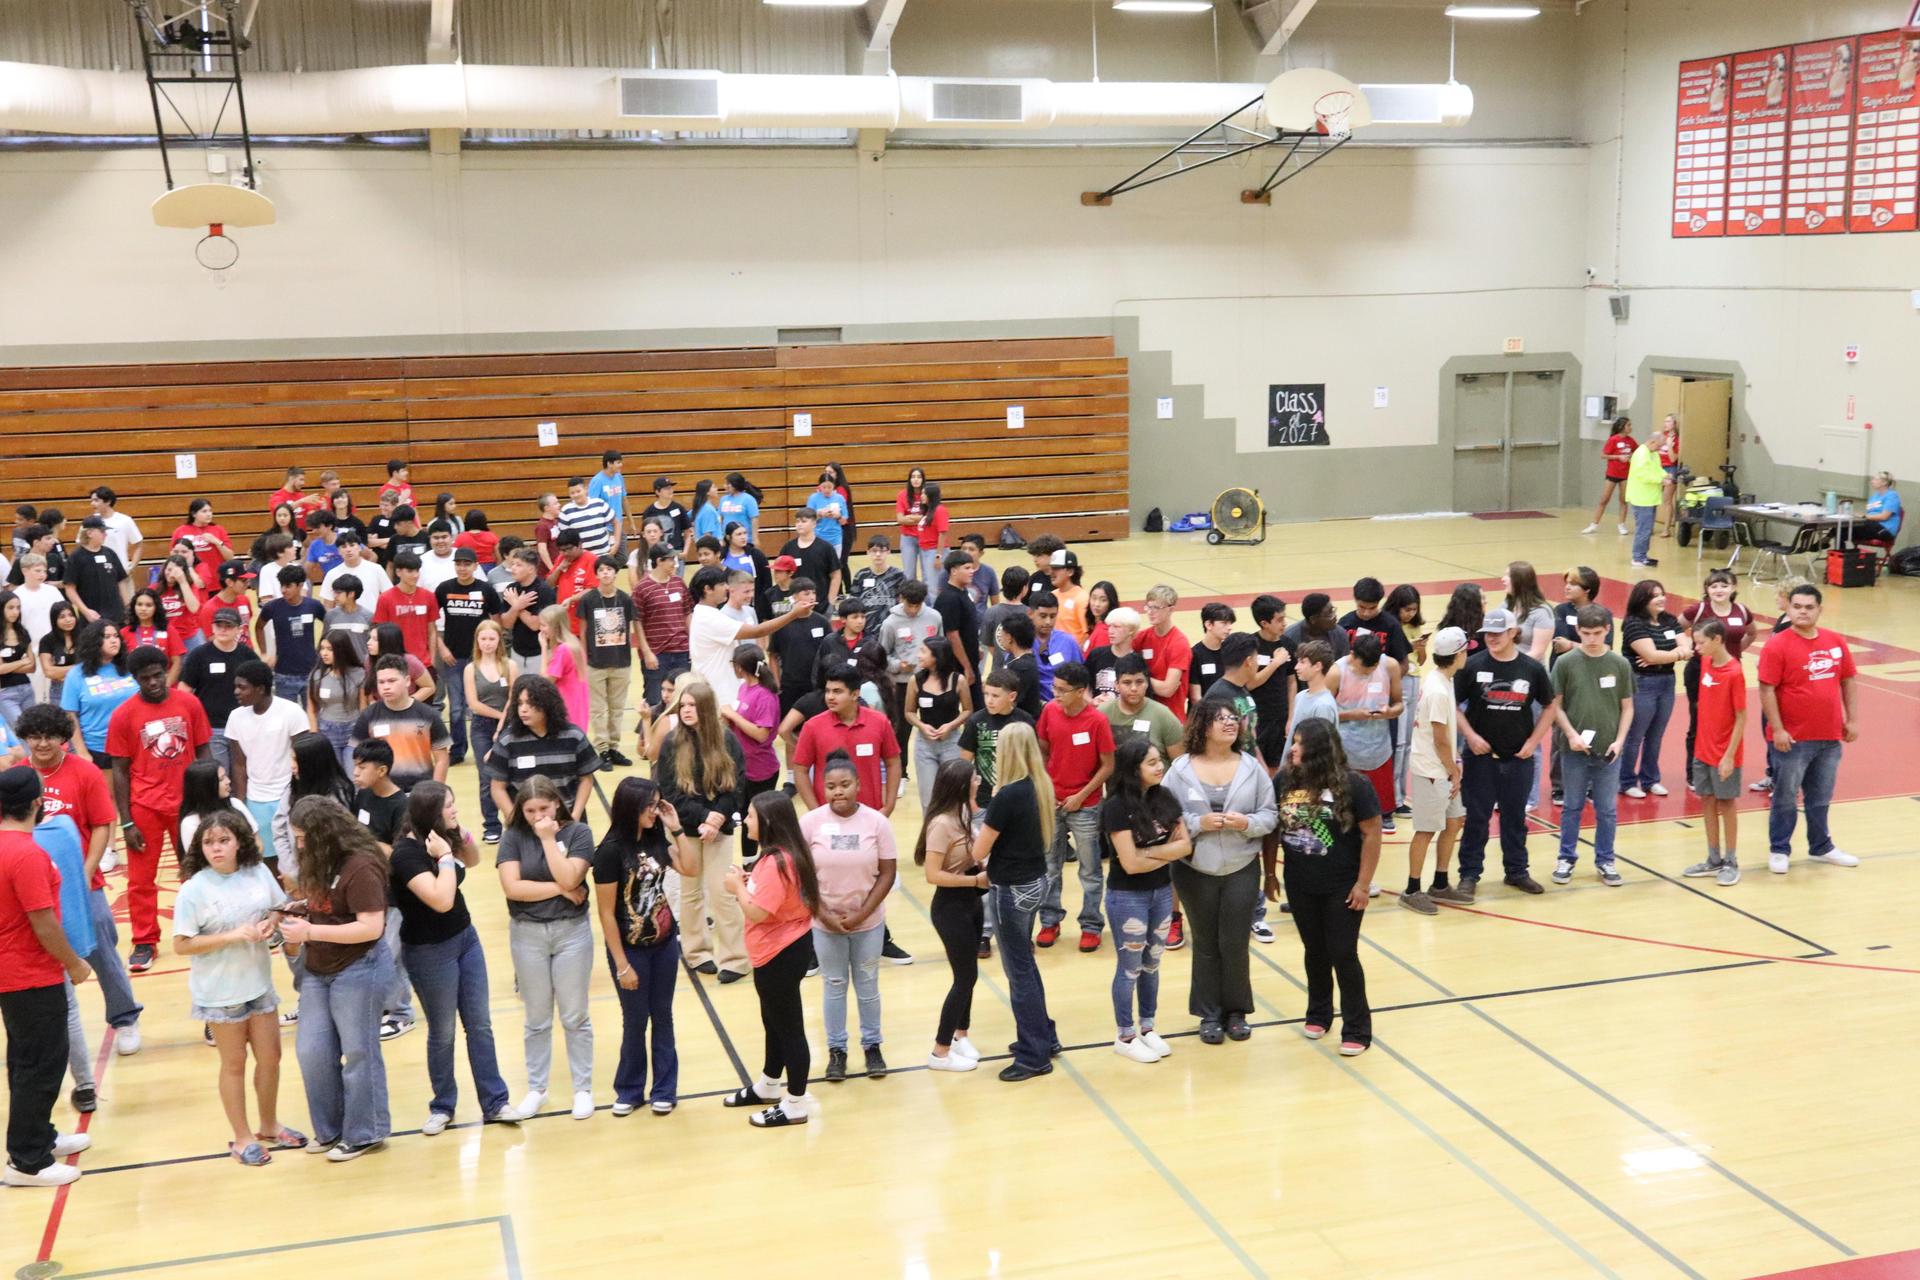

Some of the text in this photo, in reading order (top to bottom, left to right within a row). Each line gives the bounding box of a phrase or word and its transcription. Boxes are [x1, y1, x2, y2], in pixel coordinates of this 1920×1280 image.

[1275, 391, 1317, 414] Class
[1279, 423, 1318, 444] 2027
[180, 459, 193, 469] 13
[447, 599, 484, 609] ARIAT
[1809, 658, 1833, 671] ASB
